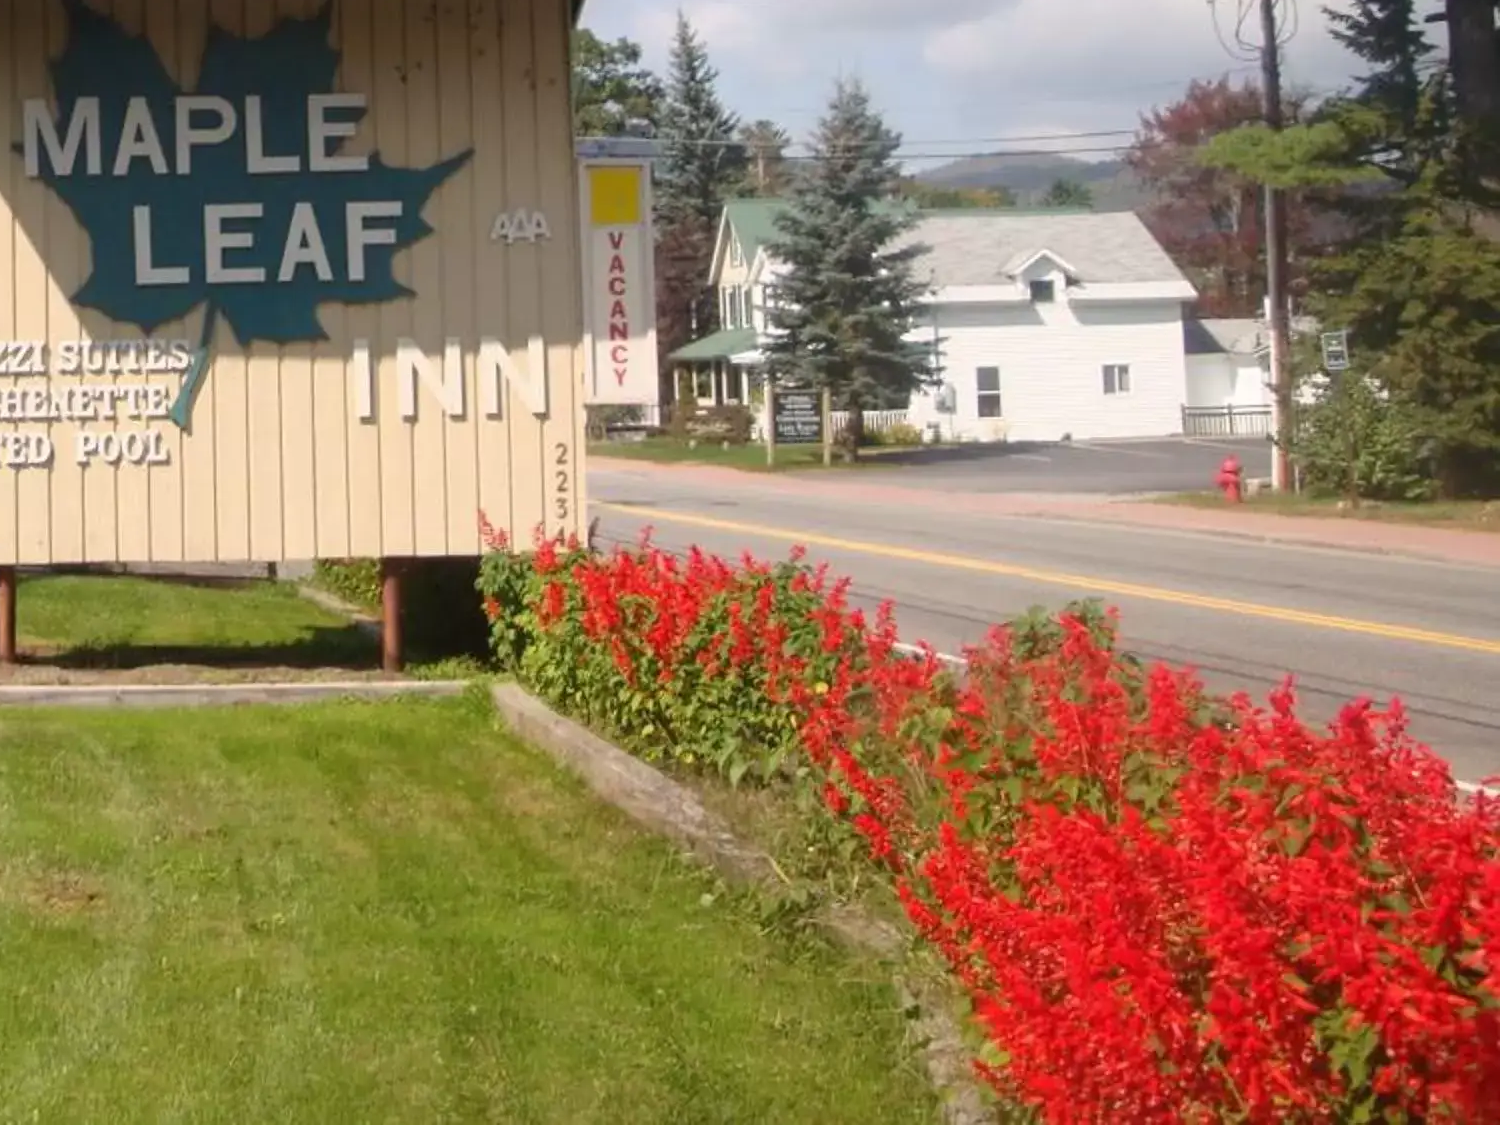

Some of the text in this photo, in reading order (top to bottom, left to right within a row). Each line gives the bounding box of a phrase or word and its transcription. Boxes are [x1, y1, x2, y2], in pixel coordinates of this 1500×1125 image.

[22, 94, 370, 176] MAPLE
[133, 201, 403, 286] LEAF
[490, 208, 551, 243] AAA
[608, 232, 629, 386] VACANCY
[58, 340, 190, 373] SUITES
[353, 335, 547, 419] INN
[77, 429, 169, 464] POOL
[554, 442, 569, 547] 2234
